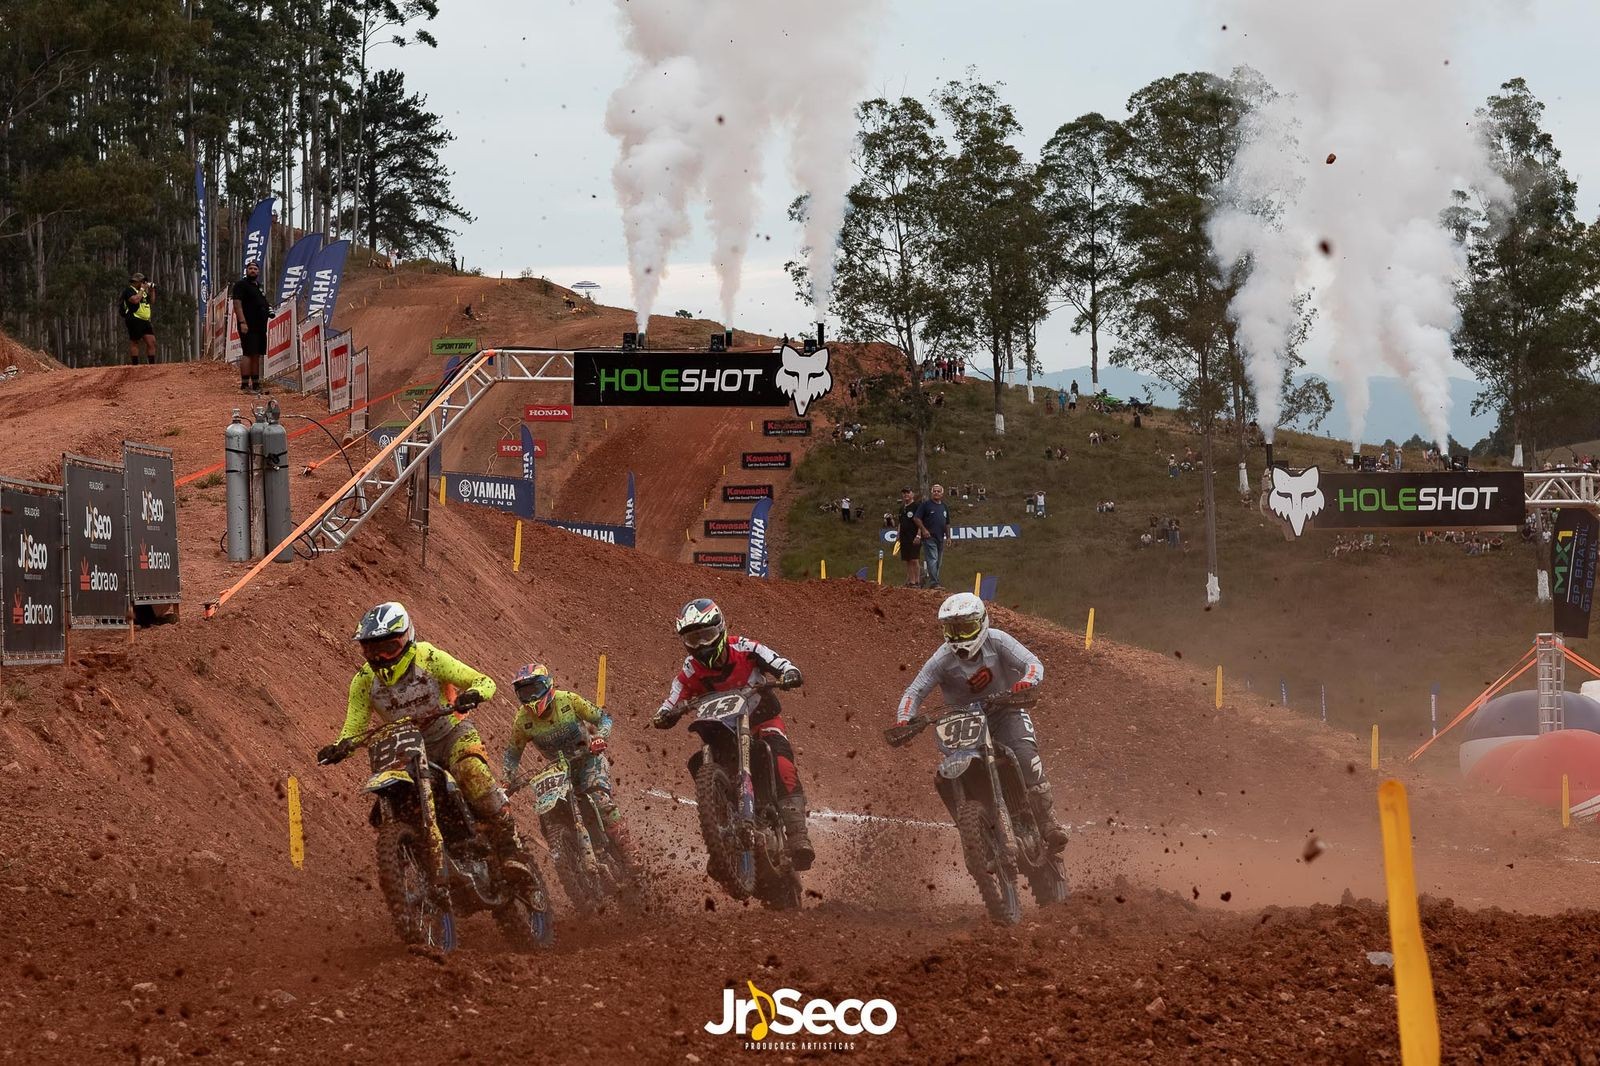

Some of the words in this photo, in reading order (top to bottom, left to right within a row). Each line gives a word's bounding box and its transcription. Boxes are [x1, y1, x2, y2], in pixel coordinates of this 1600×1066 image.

[601, 368, 762, 392] HOLESHOT
[464, 498, 512, 506] RACING
[472, 482, 516, 500] YAMAHA
[1339, 487, 1498, 512] HOLESHOT
[749, 518, 764, 577] YAMAHA
[943, 717, 980, 747] 96
